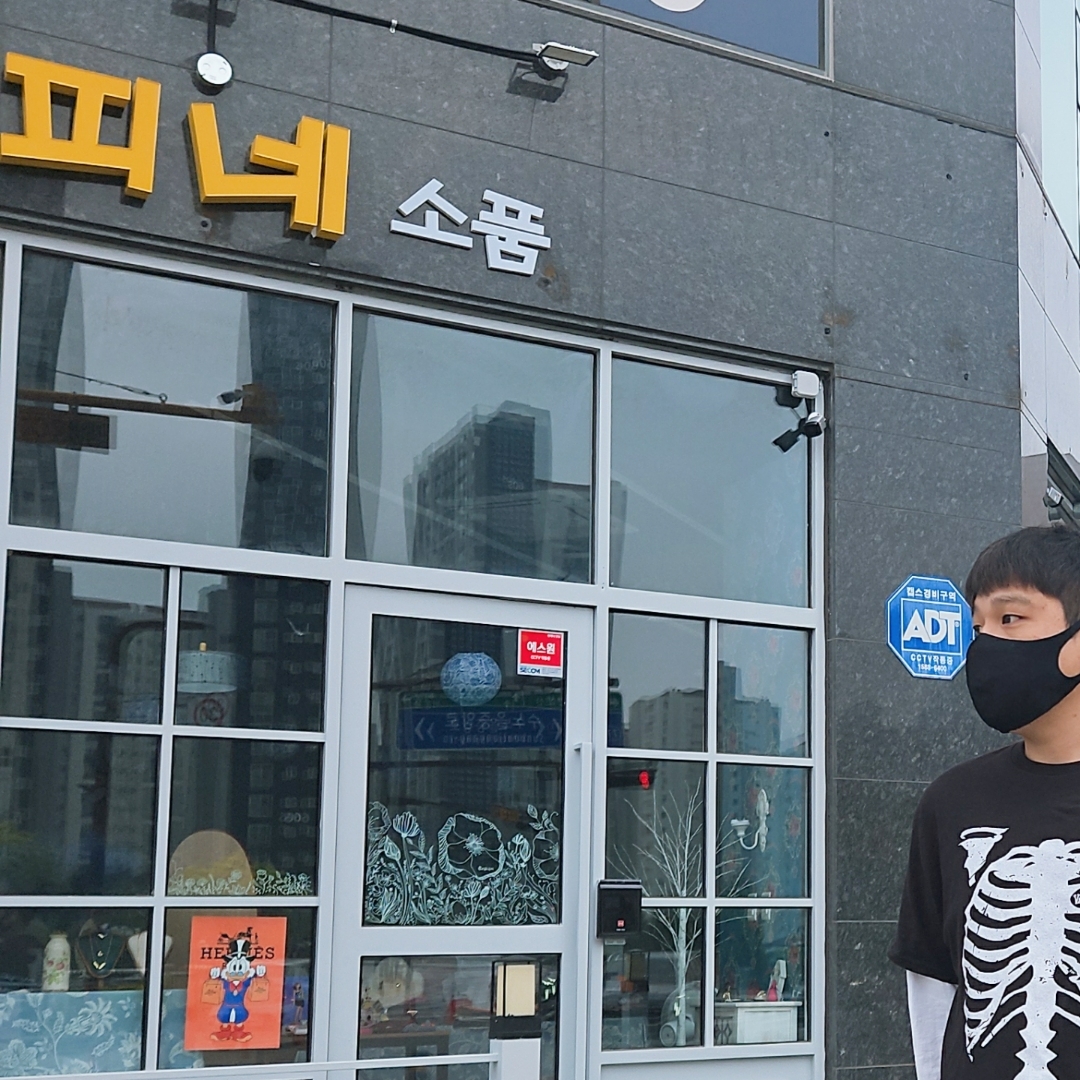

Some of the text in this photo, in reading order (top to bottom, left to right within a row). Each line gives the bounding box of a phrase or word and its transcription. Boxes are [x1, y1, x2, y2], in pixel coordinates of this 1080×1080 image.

[390, 178, 551, 276] 소품
[902, 608, 961, 645] ADT
[526, 640, 556, 655] 에스원
